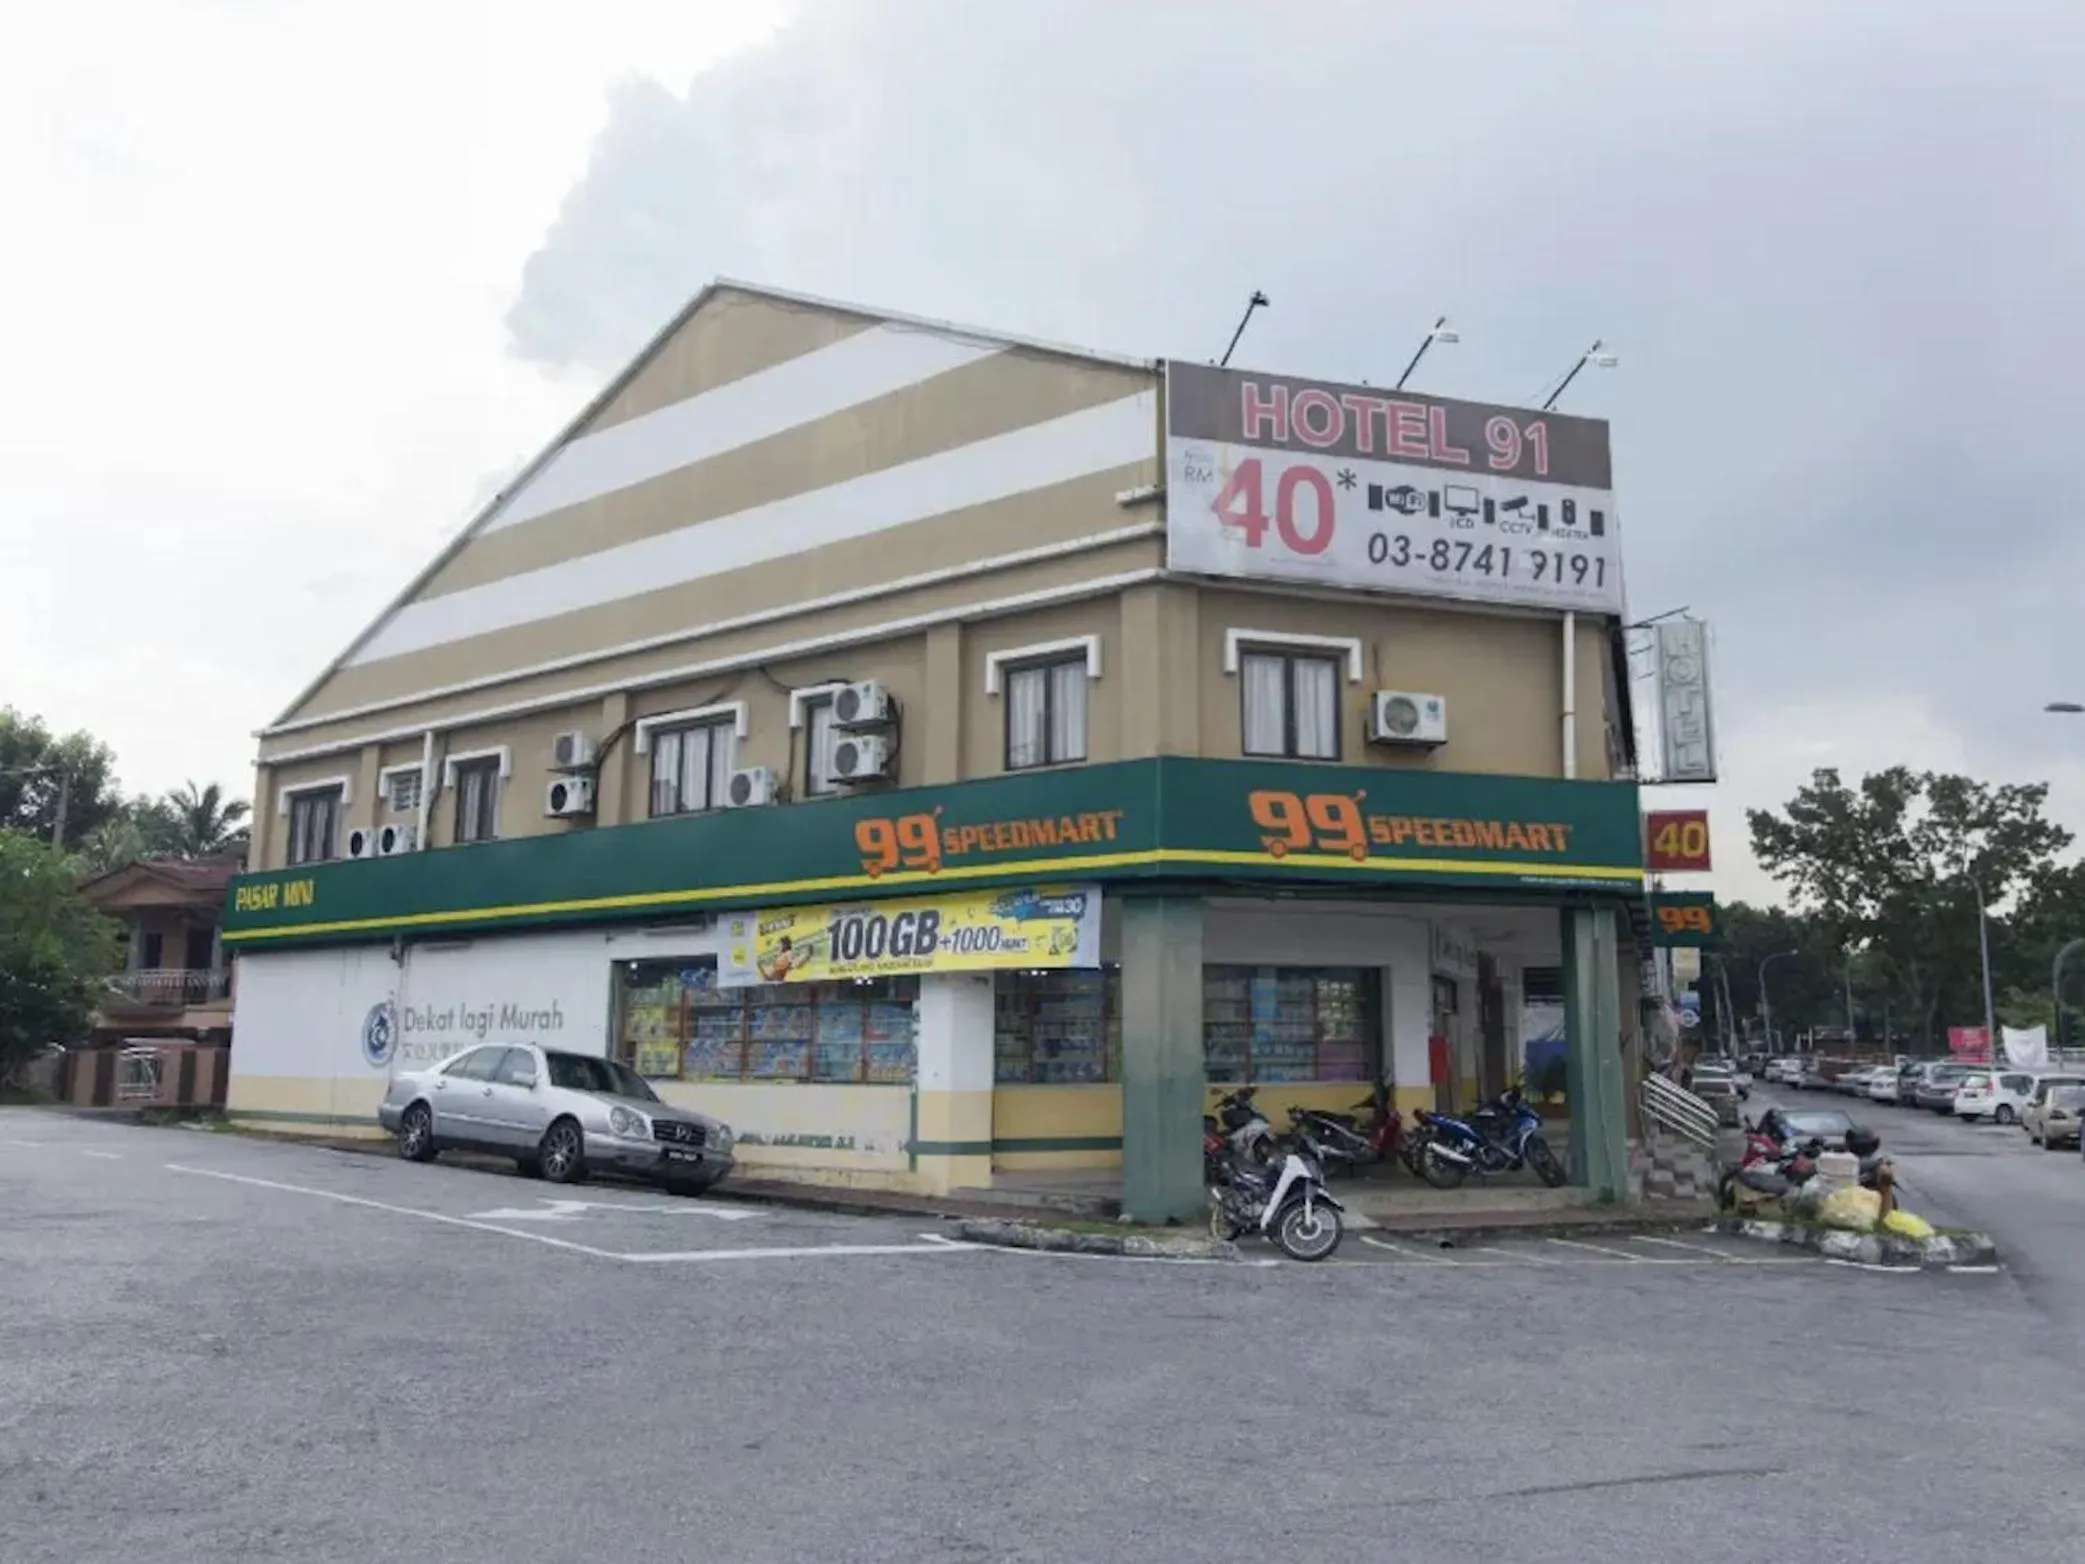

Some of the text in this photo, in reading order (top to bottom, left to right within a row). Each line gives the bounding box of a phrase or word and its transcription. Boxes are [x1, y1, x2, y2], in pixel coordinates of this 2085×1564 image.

[1241, 380, 1549, 476] HOTEL 91
[1500, 523, 1532, 536] CCTV
[1368, 532, 1512, 578] 03-8741
[1530, 549, 1605, 589] 9191
[1665, 625, 1707, 777] HOTEL
[855, 806, 1124, 879] 99 SPEEDMART
[1249, 790, 1573, 862] 99 SPEEDMART
[1654, 820, 1706, 858] 40
[827, 909, 940, 963] 100GB
[1657, 906, 1712, 934] 99
[404, 1000, 564, 1038] Dekat lagi Murah
